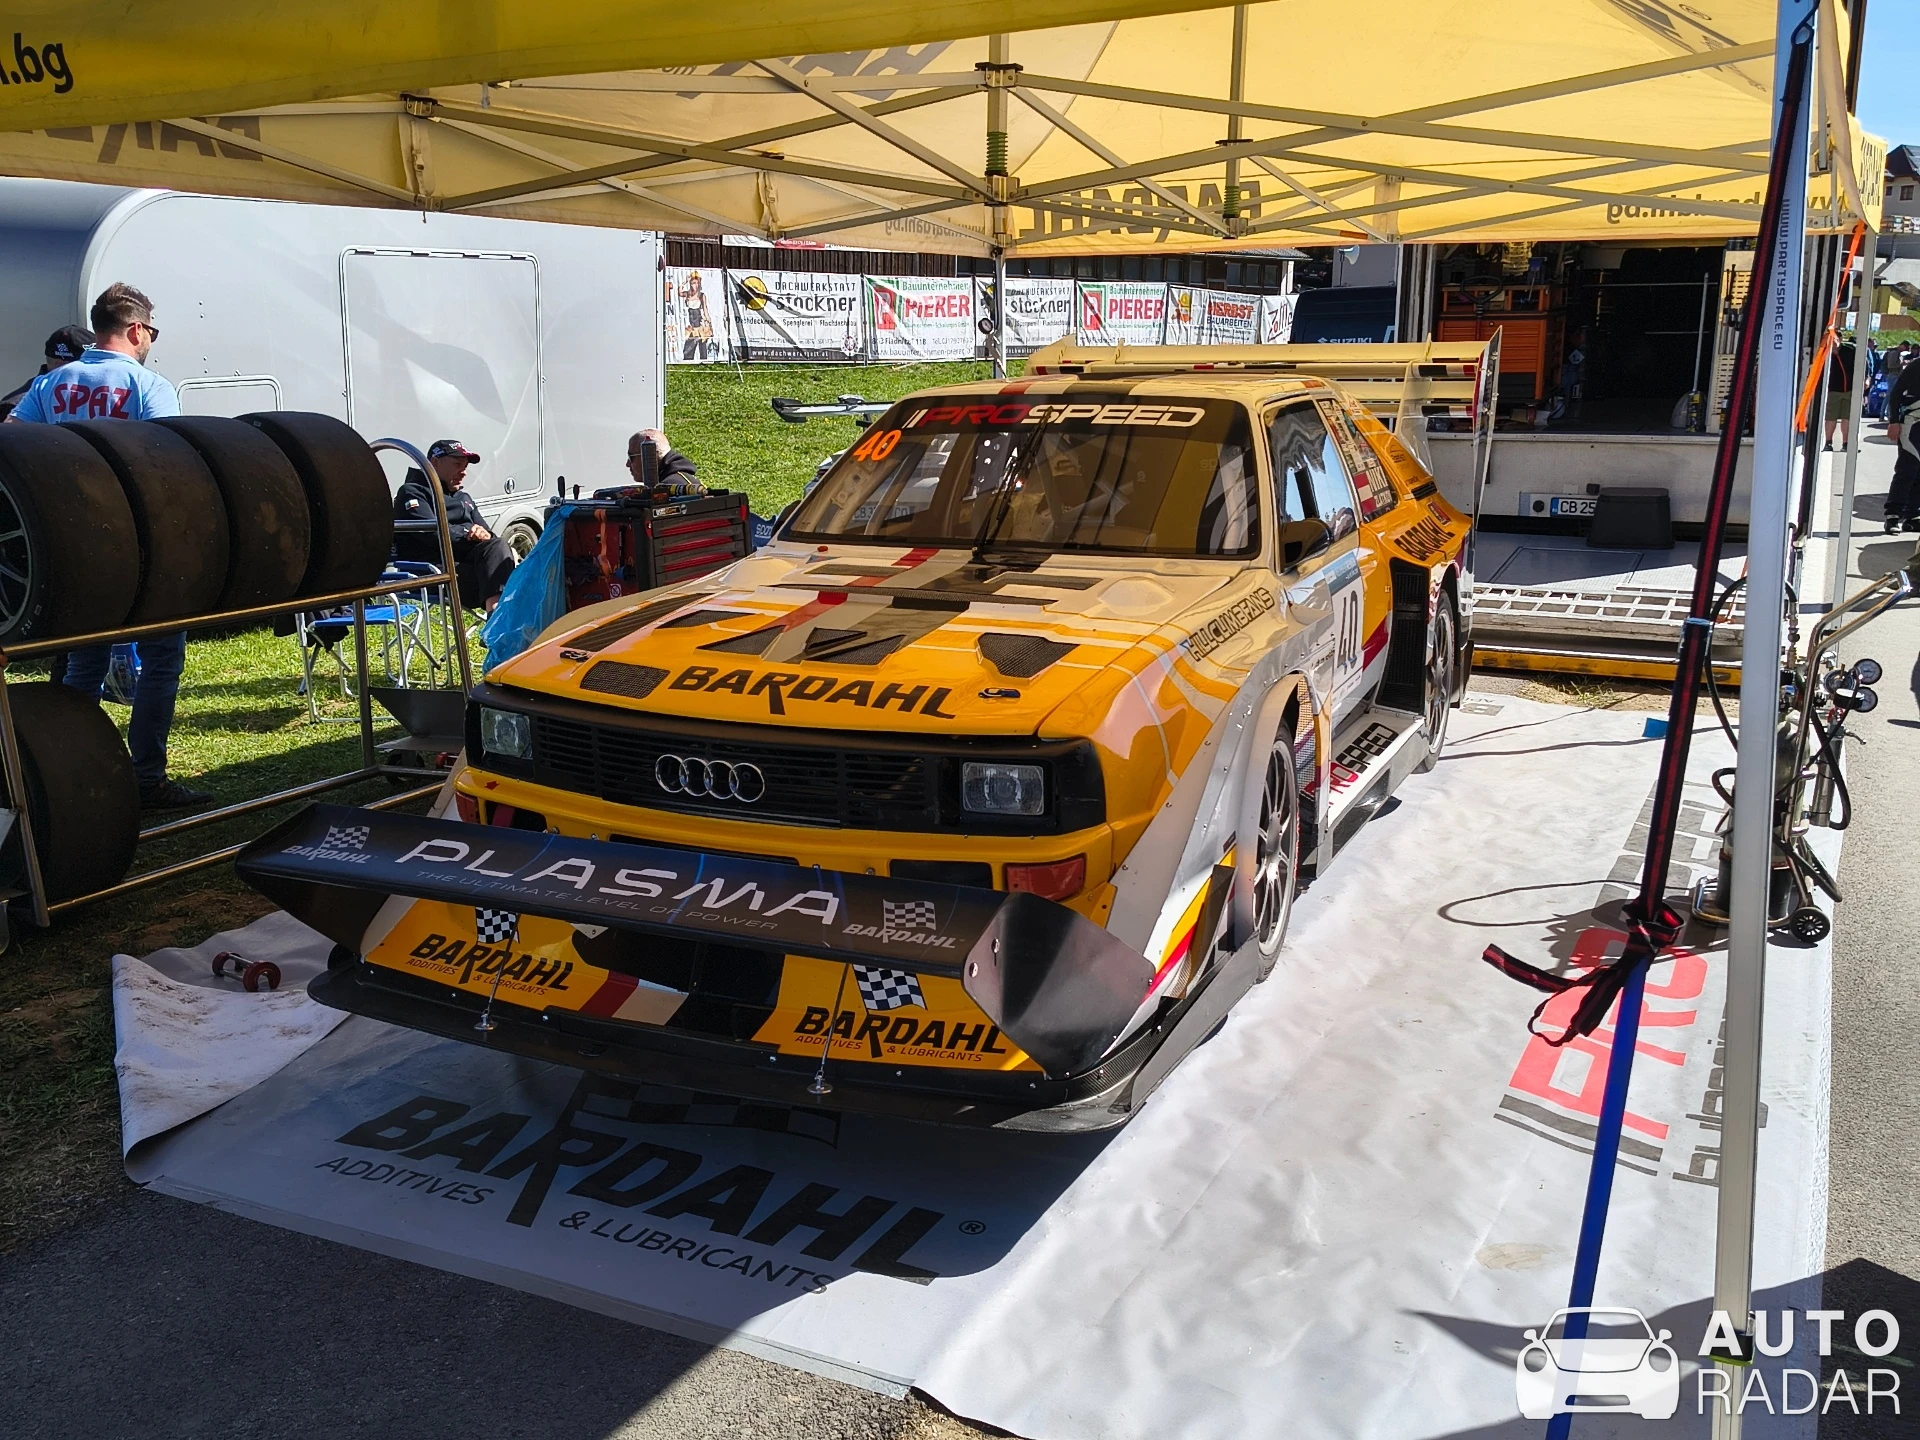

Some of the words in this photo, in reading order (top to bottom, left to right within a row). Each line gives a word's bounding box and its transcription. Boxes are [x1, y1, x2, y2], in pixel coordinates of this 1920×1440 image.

[1108, 298, 1165, 320] PIERER
[1207, 300, 1254, 320] HERBST
[1207, 315, 1253, 328] BAUARBEITEN
[53, 383, 133, 420] SPAZ
[914, 404, 1206, 428] PROSPEED
[853, 429, 902, 463] 40
[1393, 515, 1456, 562] BARDAHL
[1336, 590, 1359, 675] 40
[667, 666, 956, 720] BARDAHL
[281, 845, 375, 864] BARDAHL
[394, 838, 840, 925] PLASMA
[416, 871, 458, 882] THE
[459, 877, 568, 899] ULTIMATE
[573, 893, 640, 911] LEVEL
[653, 905, 683, 916] OF
[685, 911, 779, 930] POWER
[843, 922, 959, 949] BARDAHL
[405, 958, 459, 975] ADDITIVES
[472, 973, 482, 982] &
[483, 976, 549, 996] LUBRICANTS
[408, 933, 574, 991] BARDAHL
[793, 1005, 1007, 1059] BARDAHL
[794, 1035, 864, 1050] ADDITIVES
[886, 1045, 897, 1054] &
[900, 1047, 983, 1063] LUBRICANTS
[333, 1095, 946, 1287] BARDAHL
[315, 1155, 497, 1206] ADDITIVES
[558, 1210, 591, 1231] &
[590, 1218, 837, 1295] LUBRICANTS
